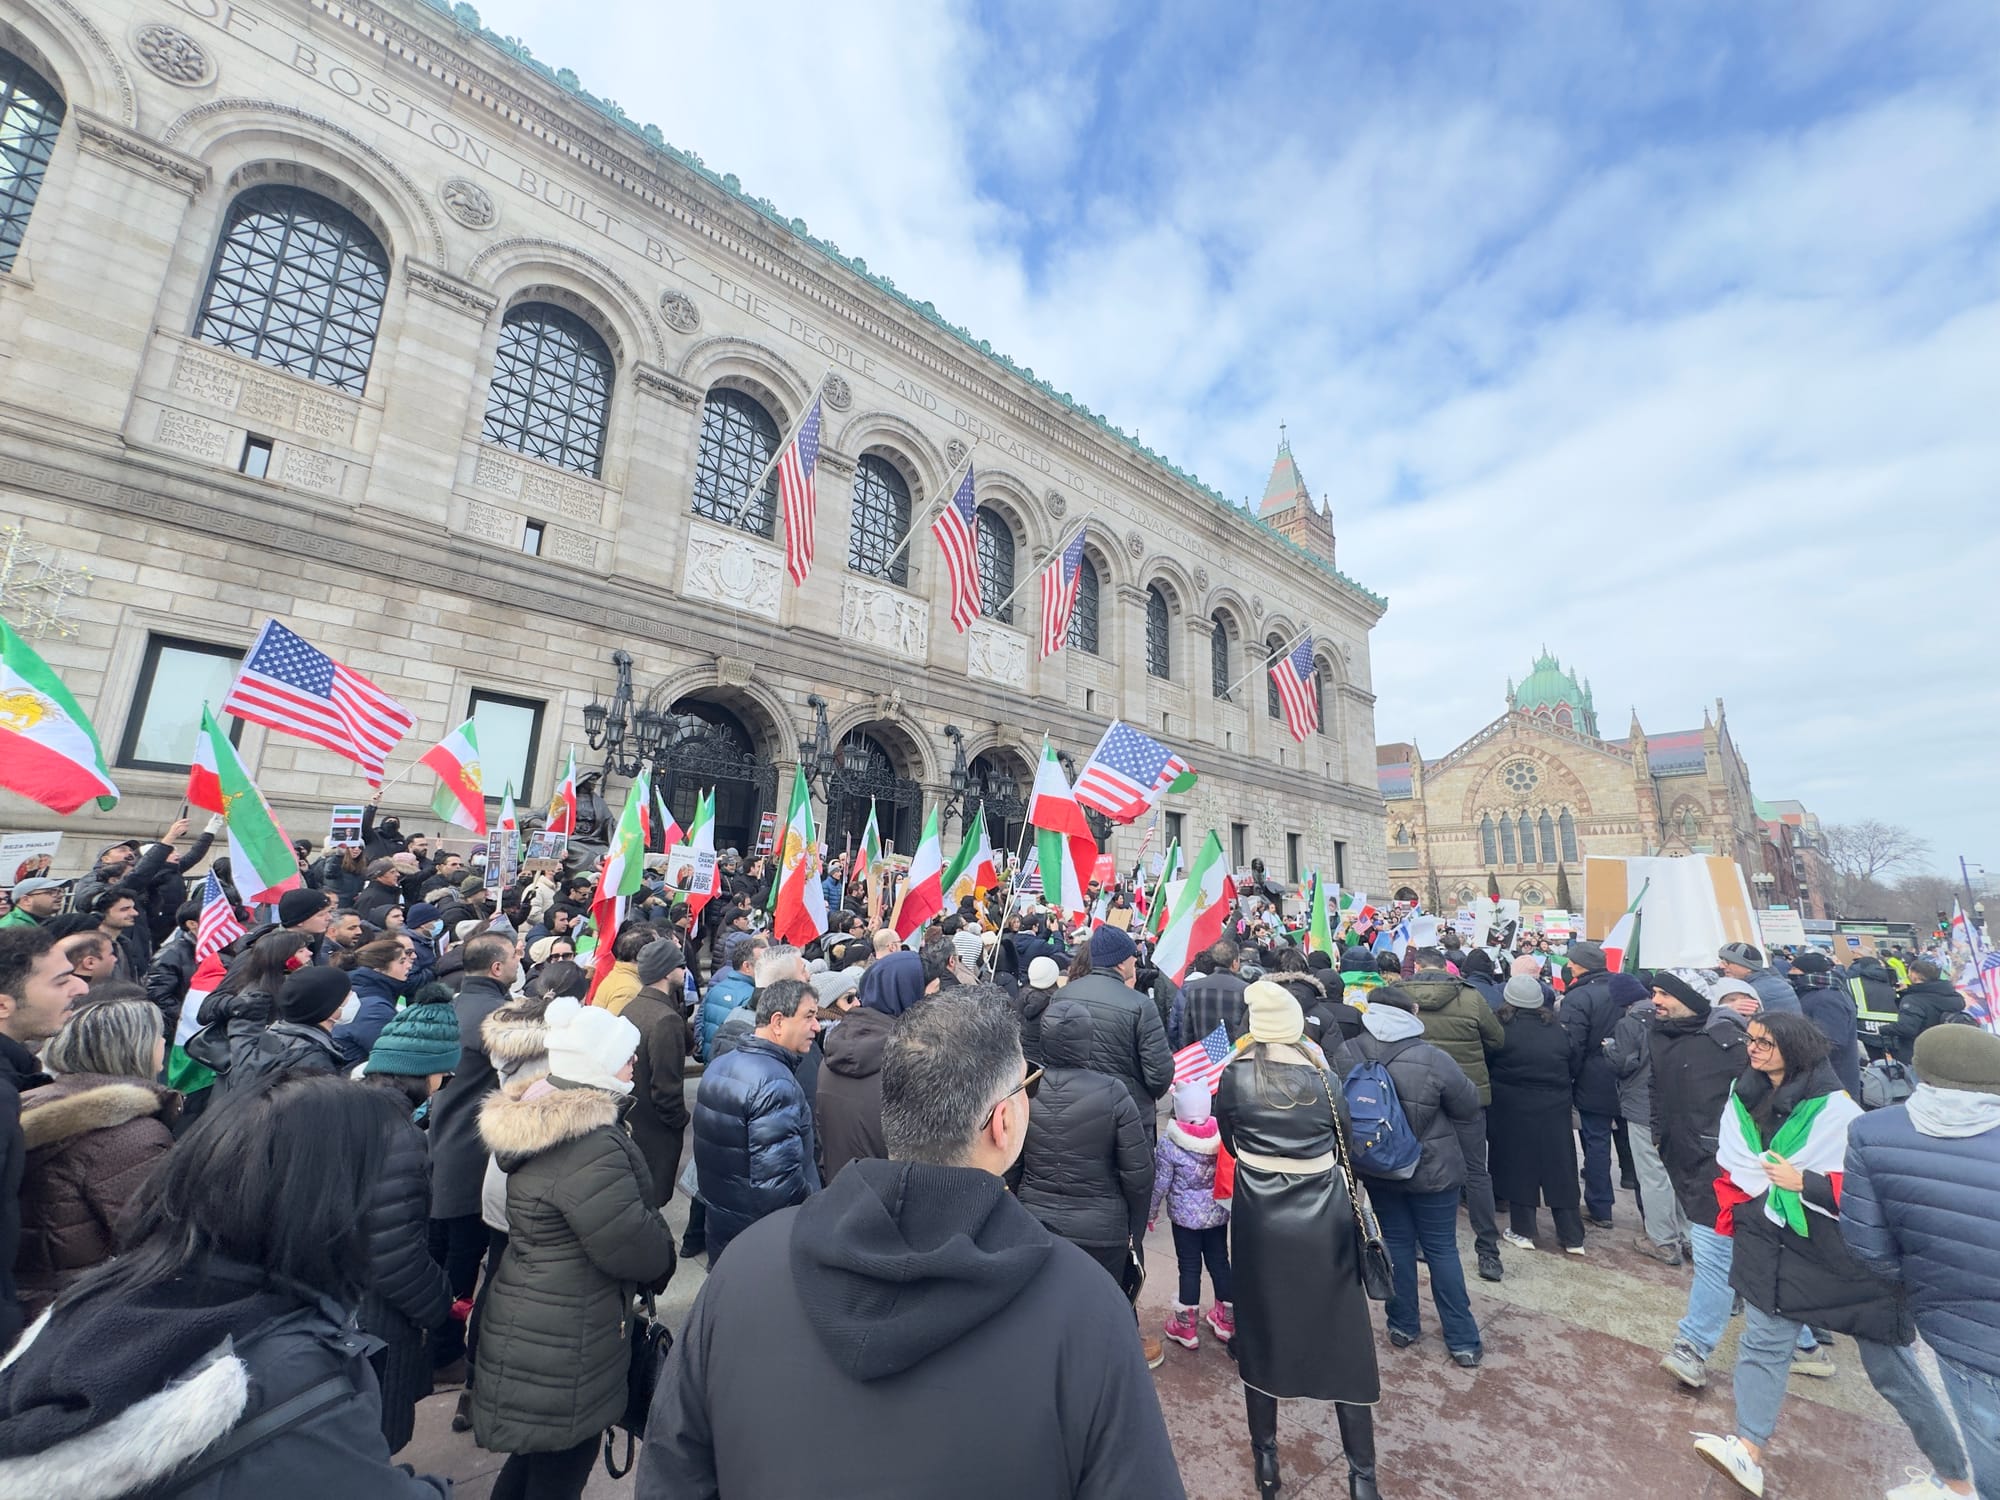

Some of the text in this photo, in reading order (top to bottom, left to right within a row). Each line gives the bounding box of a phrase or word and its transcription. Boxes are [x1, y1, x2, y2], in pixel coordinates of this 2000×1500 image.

[182, 0, 258, 32] OF
[292, 43, 490, 168] BOSTON
[517, 168, 620, 236] BUILT
[645, 238, 685, 271] BY
[711, 274, 770, 322] THE
[789, 318, 876, 378] PEOPLE
[893, 380, 937, 411] AND
[954, 409, 1050, 473] DEDICATED
[1064, 470, 1084, 490] TO
[1093, 486, 1121, 511] THE
[1128, 507, 1212, 560] ADVANCEMENT
[177, 373, 235, 398] LALANDE
[180, 365, 230, 388] KEPLER
[175, 381, 232, 406] LAPLACE
[167, 411, 209, 429] GALEN
[287, 464, 336, 484] WHITNEY
